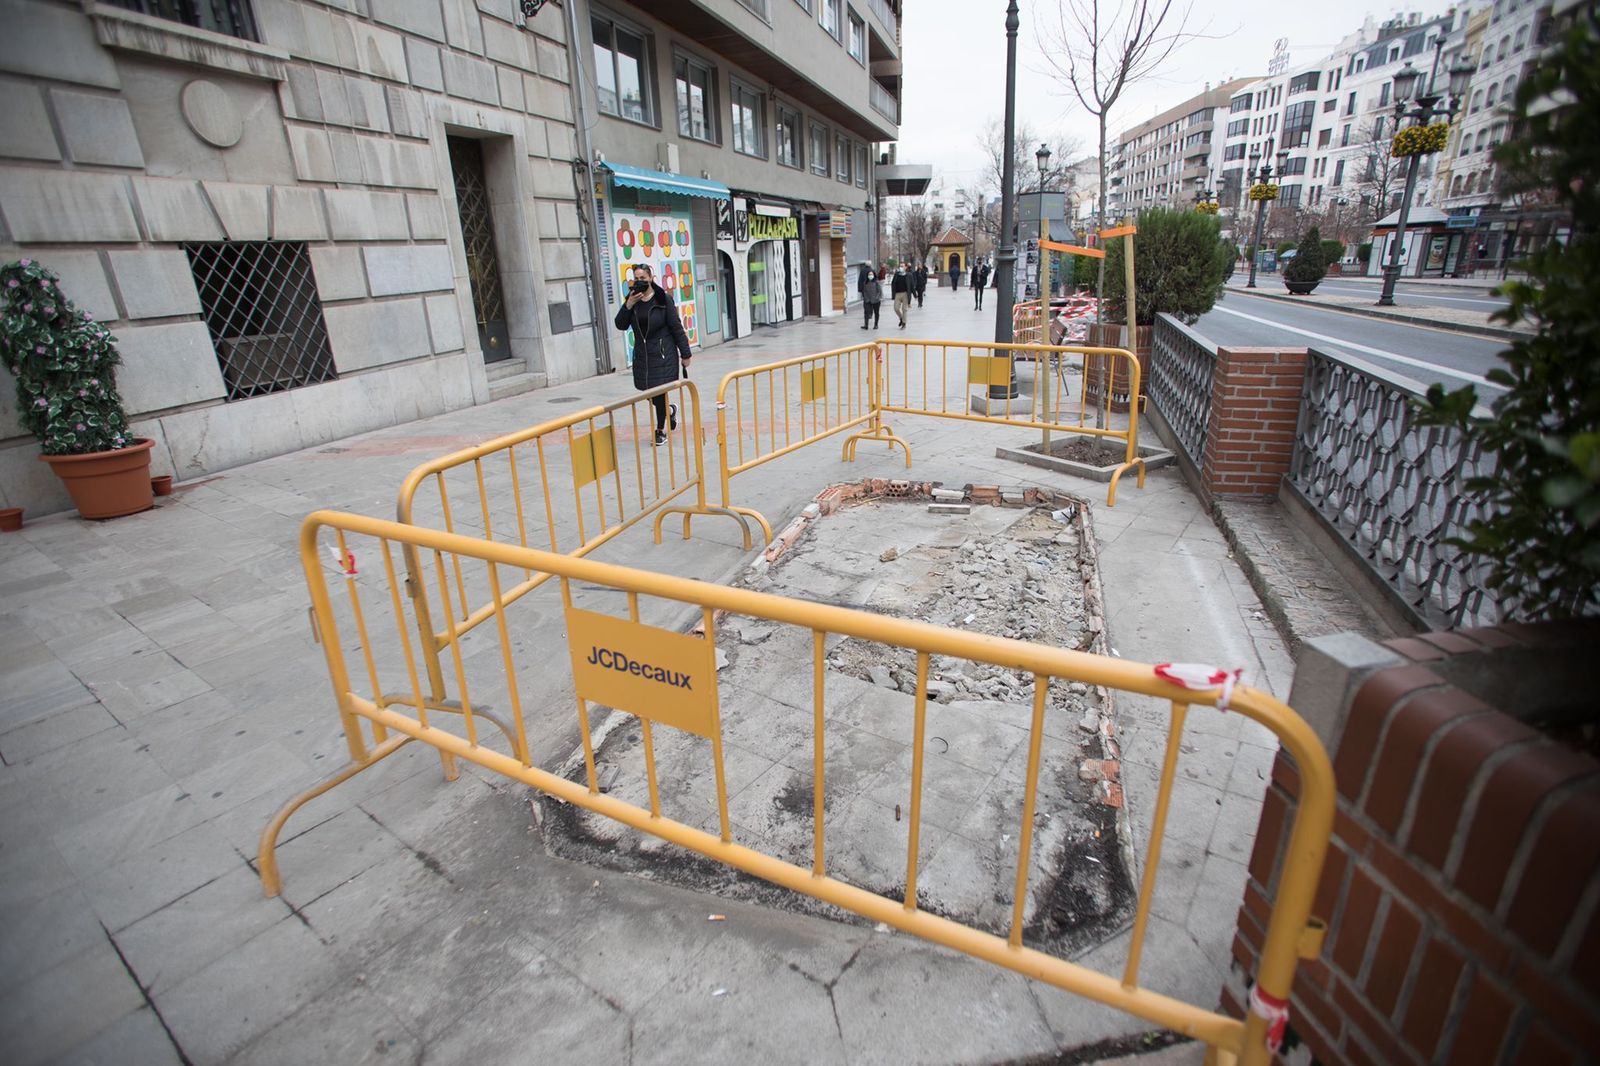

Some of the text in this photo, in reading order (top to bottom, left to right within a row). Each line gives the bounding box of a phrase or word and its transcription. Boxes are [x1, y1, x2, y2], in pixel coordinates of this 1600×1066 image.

[748, 213, 774, 239] PIZZA
[778, 216, 799, 239] PASTA
[587, 646, 692, 690] JCDecaux
